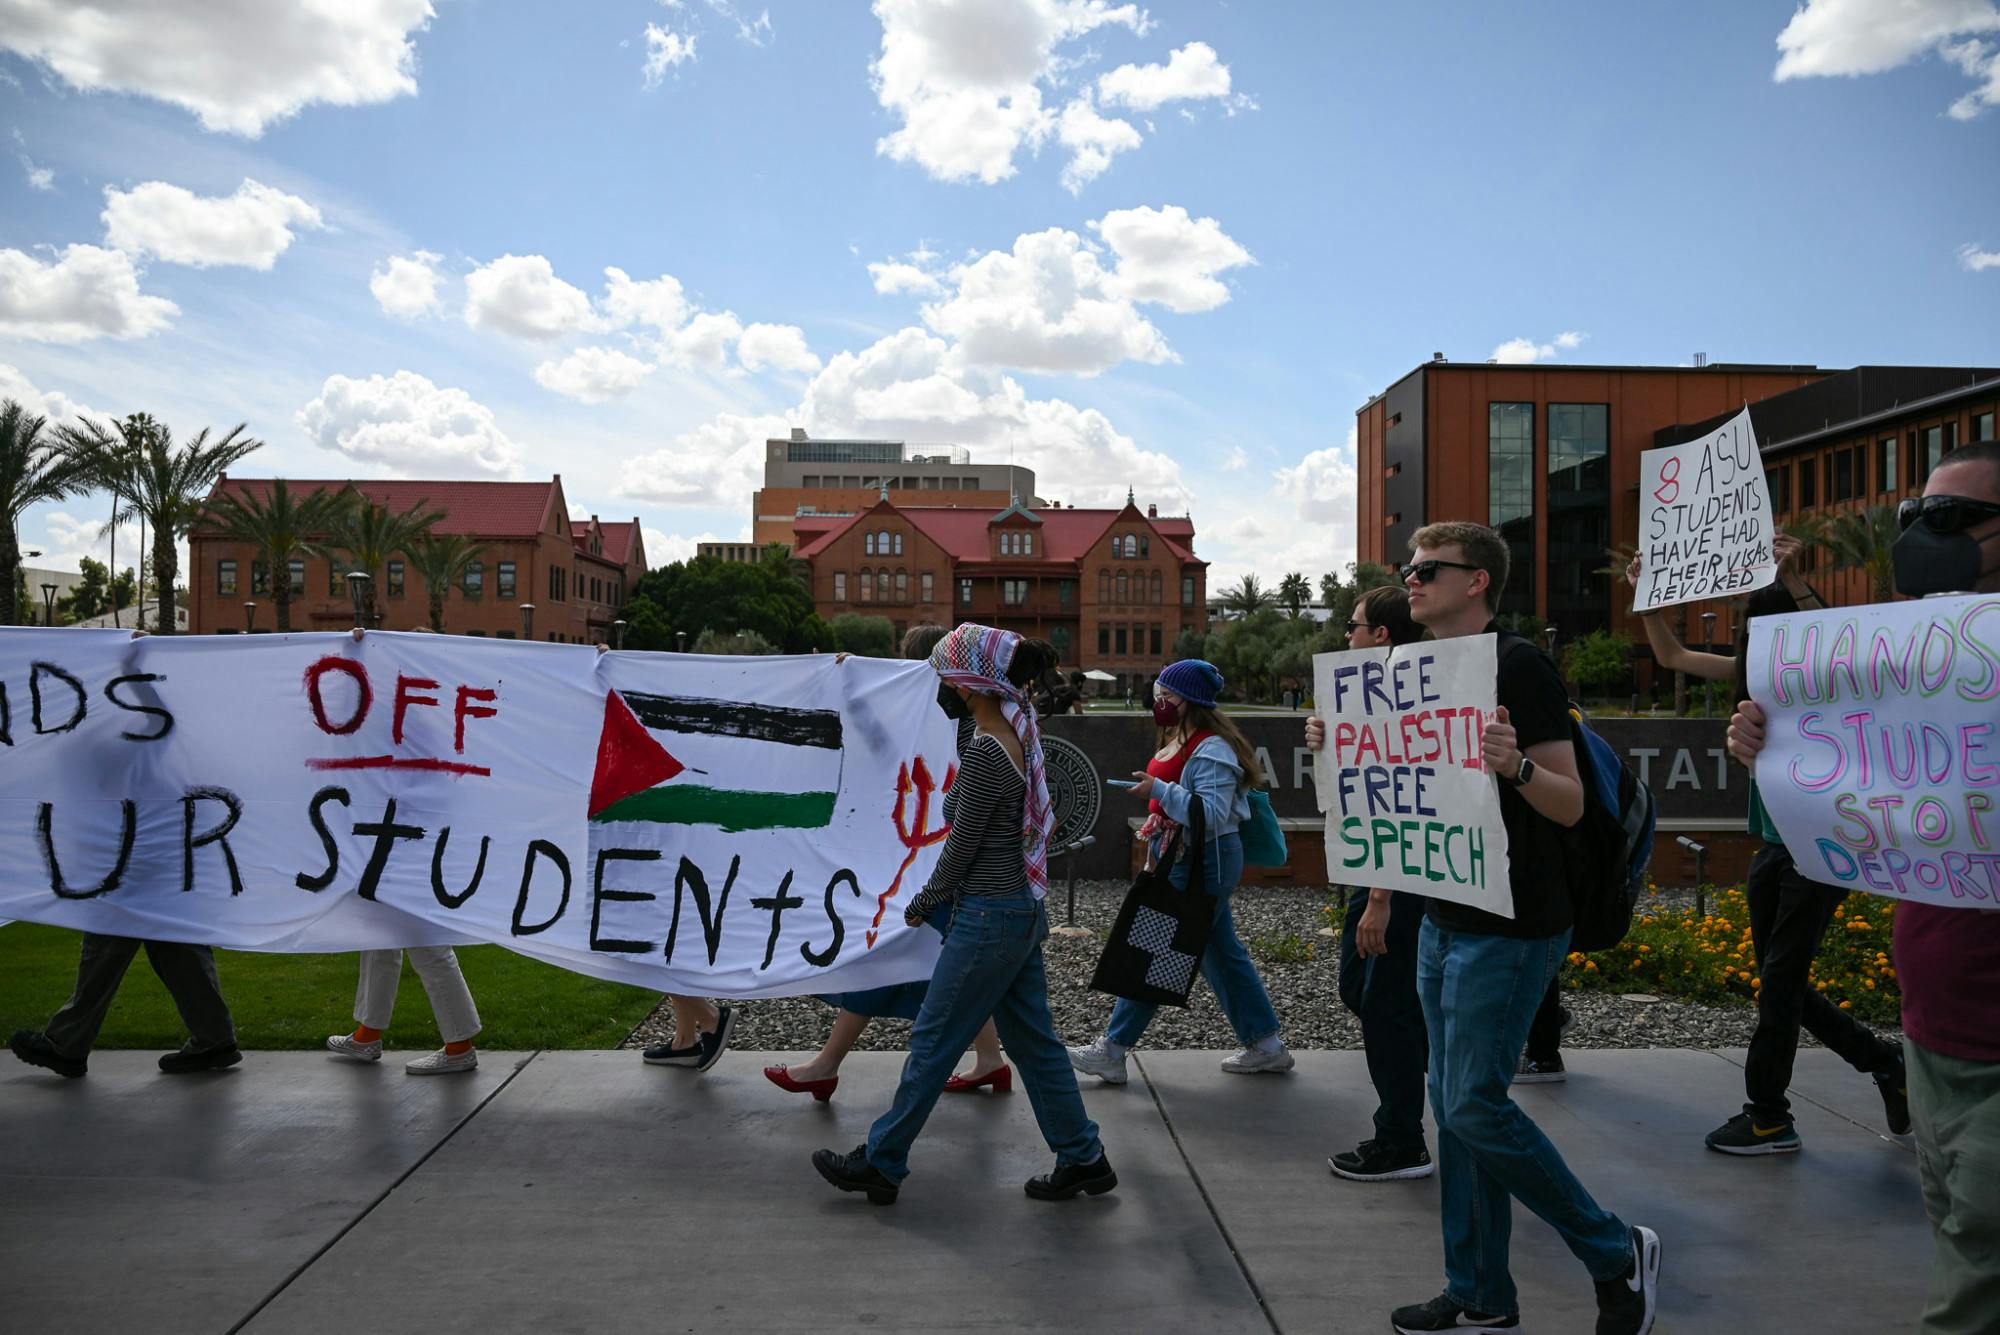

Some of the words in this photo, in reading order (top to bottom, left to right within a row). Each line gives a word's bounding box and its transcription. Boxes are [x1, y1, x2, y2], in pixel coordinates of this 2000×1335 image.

[1654, 456, 1681, 505] 8
[1695, 420, 1751, 495] ASU
[1650, 477, 1762, 541] STUDENTS
[1650, 527, 1714, 567] HAVE
[1720, 517, 1760, 549] HAD
[1652, 553, 1723, 591] THEIR
[1648, 568, 1754, 607] REVOKED
[1334, 655, 1441, 715] FREE
[1769, 601, 2000, 707] HANDS
[0, 661, 175, 746] DS
[304, 654, 498, 755] OFF
[1629, 748, 1728, 790] TAT
[1788, 708, 2000, 794] STUDE
[1055, 752, 1089, 833] UNIVERSITY
[1338, 765, 1437, 817] FREE
[1834, 793, 1993, 851] STOP
[1339, 816, 1486, 890] SPEECH
[1815, 837, 2000, 903] DEPORT
